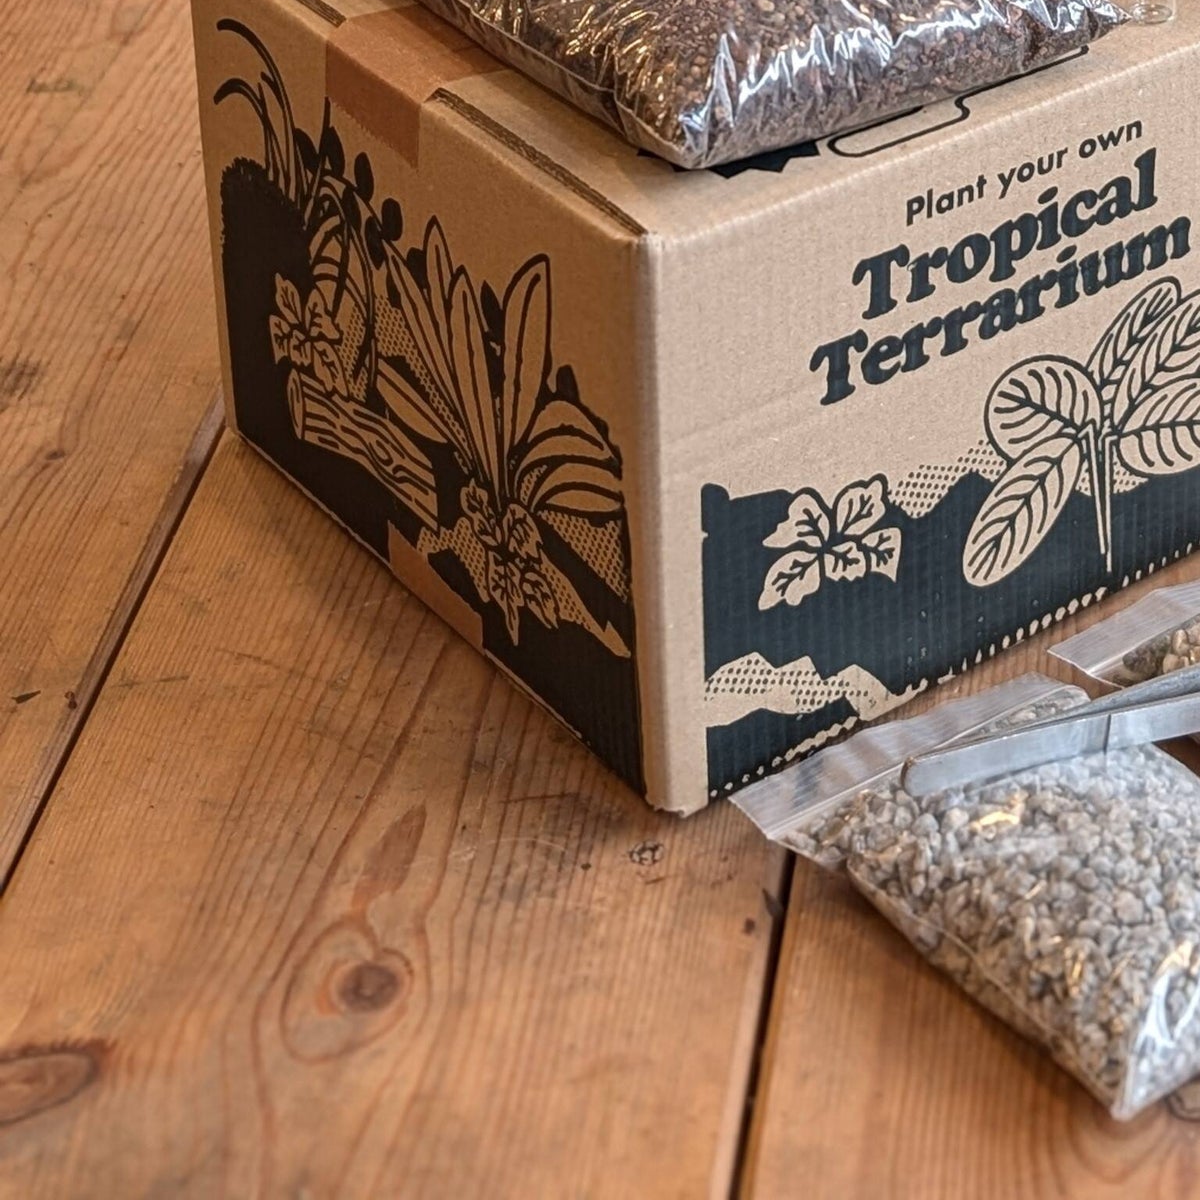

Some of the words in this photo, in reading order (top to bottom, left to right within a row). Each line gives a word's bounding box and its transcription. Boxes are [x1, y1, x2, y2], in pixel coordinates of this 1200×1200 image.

[852, 147, 1158, 319] Tropical
[906, 174, 987, 226] Plant
[998, 147, 1069, 199] your
[1079, 120, 1143, 159] own
[809, 216, 1191, 405] Terrarium
